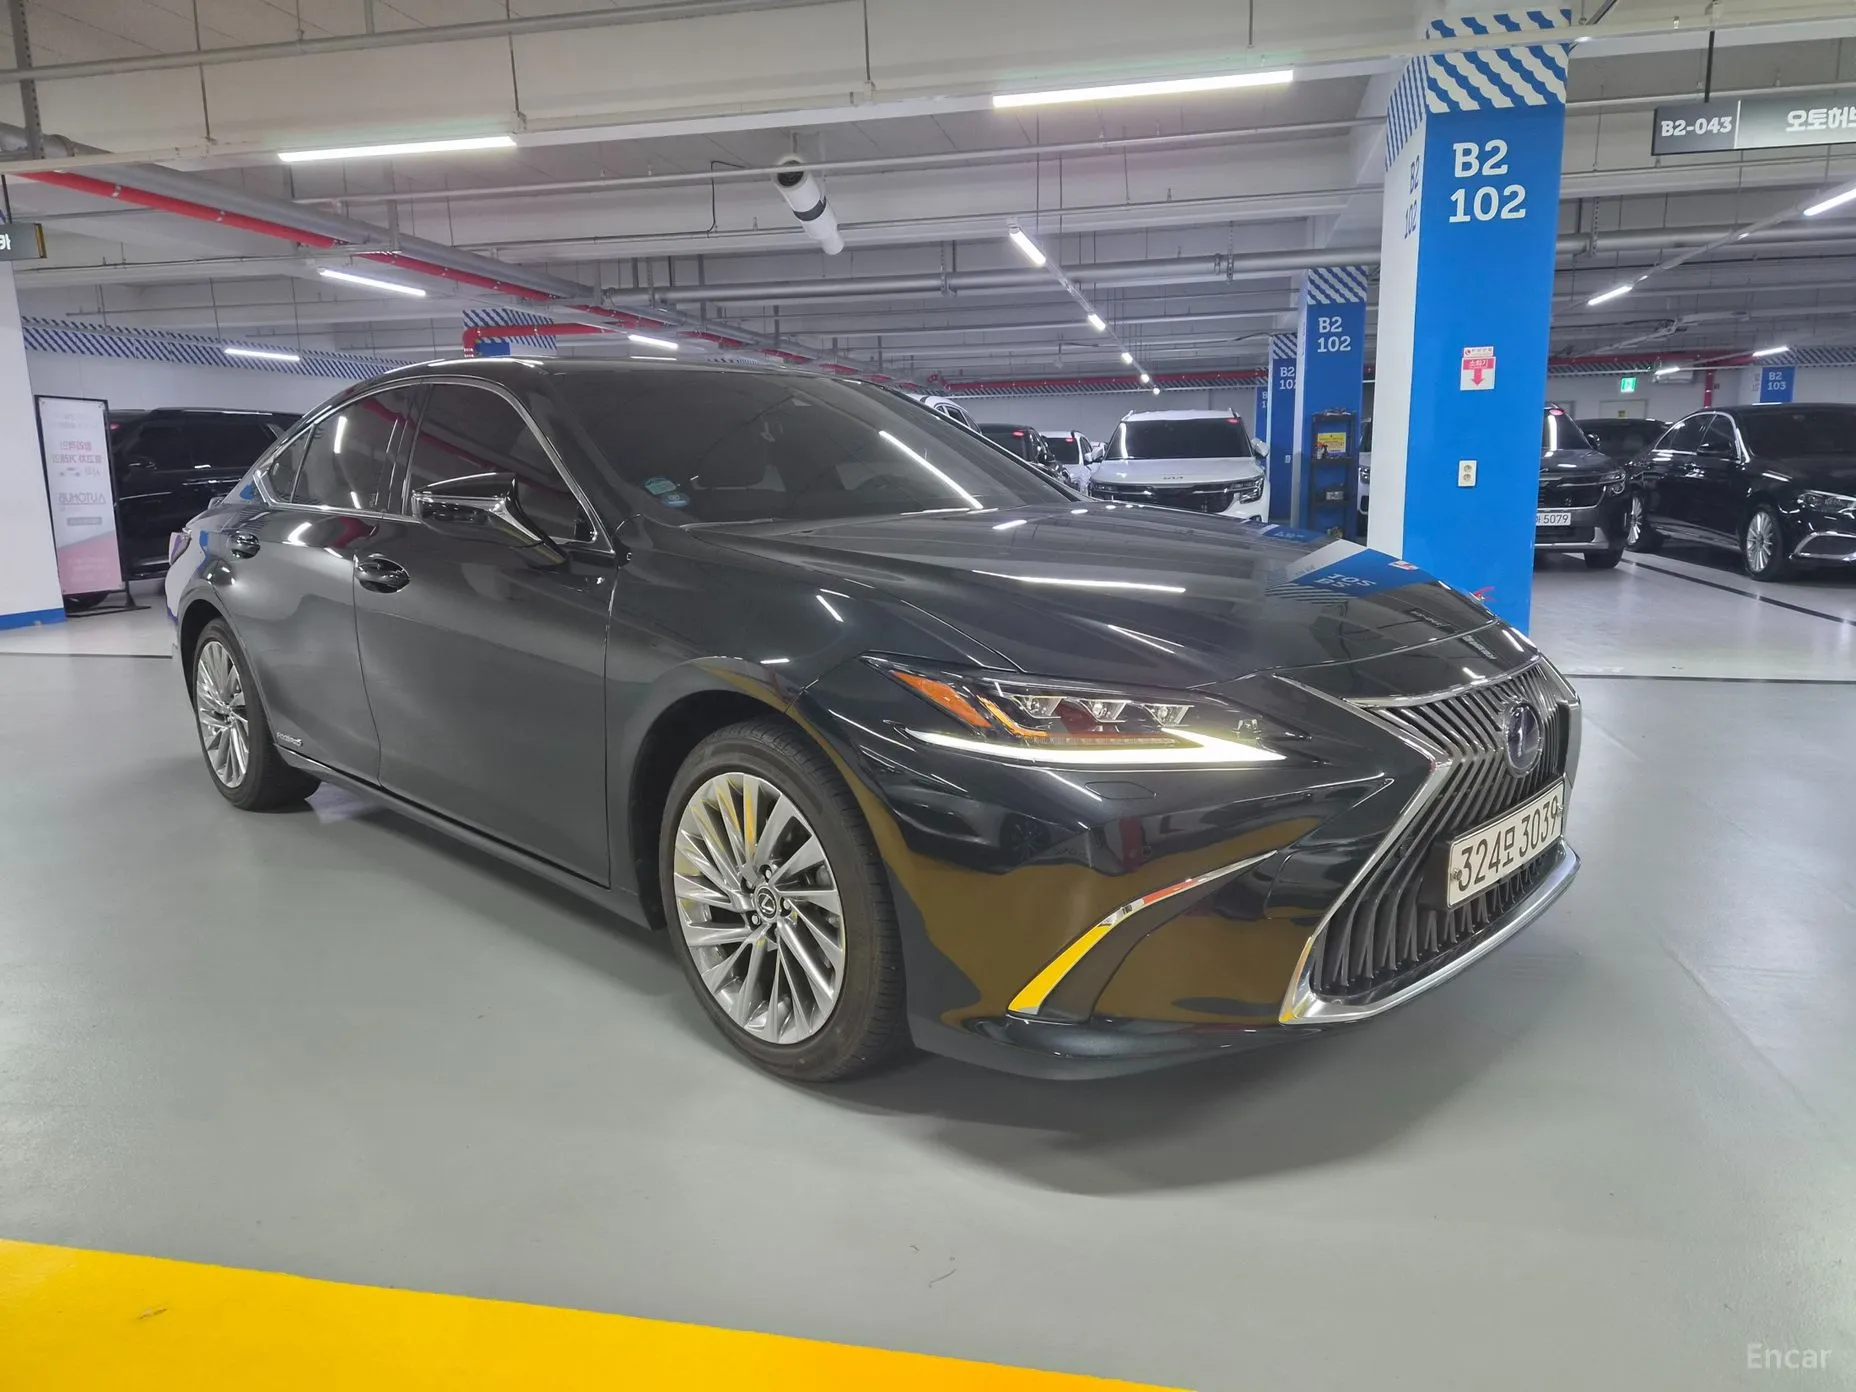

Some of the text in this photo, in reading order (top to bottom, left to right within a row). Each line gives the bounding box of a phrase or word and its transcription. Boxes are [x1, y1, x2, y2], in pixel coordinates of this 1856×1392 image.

[1661, 116, 1733, 137] B2-043
[1452, 139, 1508, 178] B2
[1448, 184, 1526, 223] 102
[1318, 316, 1343, 333] B2
[1317, 335, 1352, 353] 102
[1280, 366, 1295, 377] B2
[1768, 371, 1783, 381] B2
[1279, 379, 1296, 390] 10
[1767, 381, 1787, 391] 103
[1543, 514, 1569, 524] 5079
[1458, 825, 1516, 892] 324모
